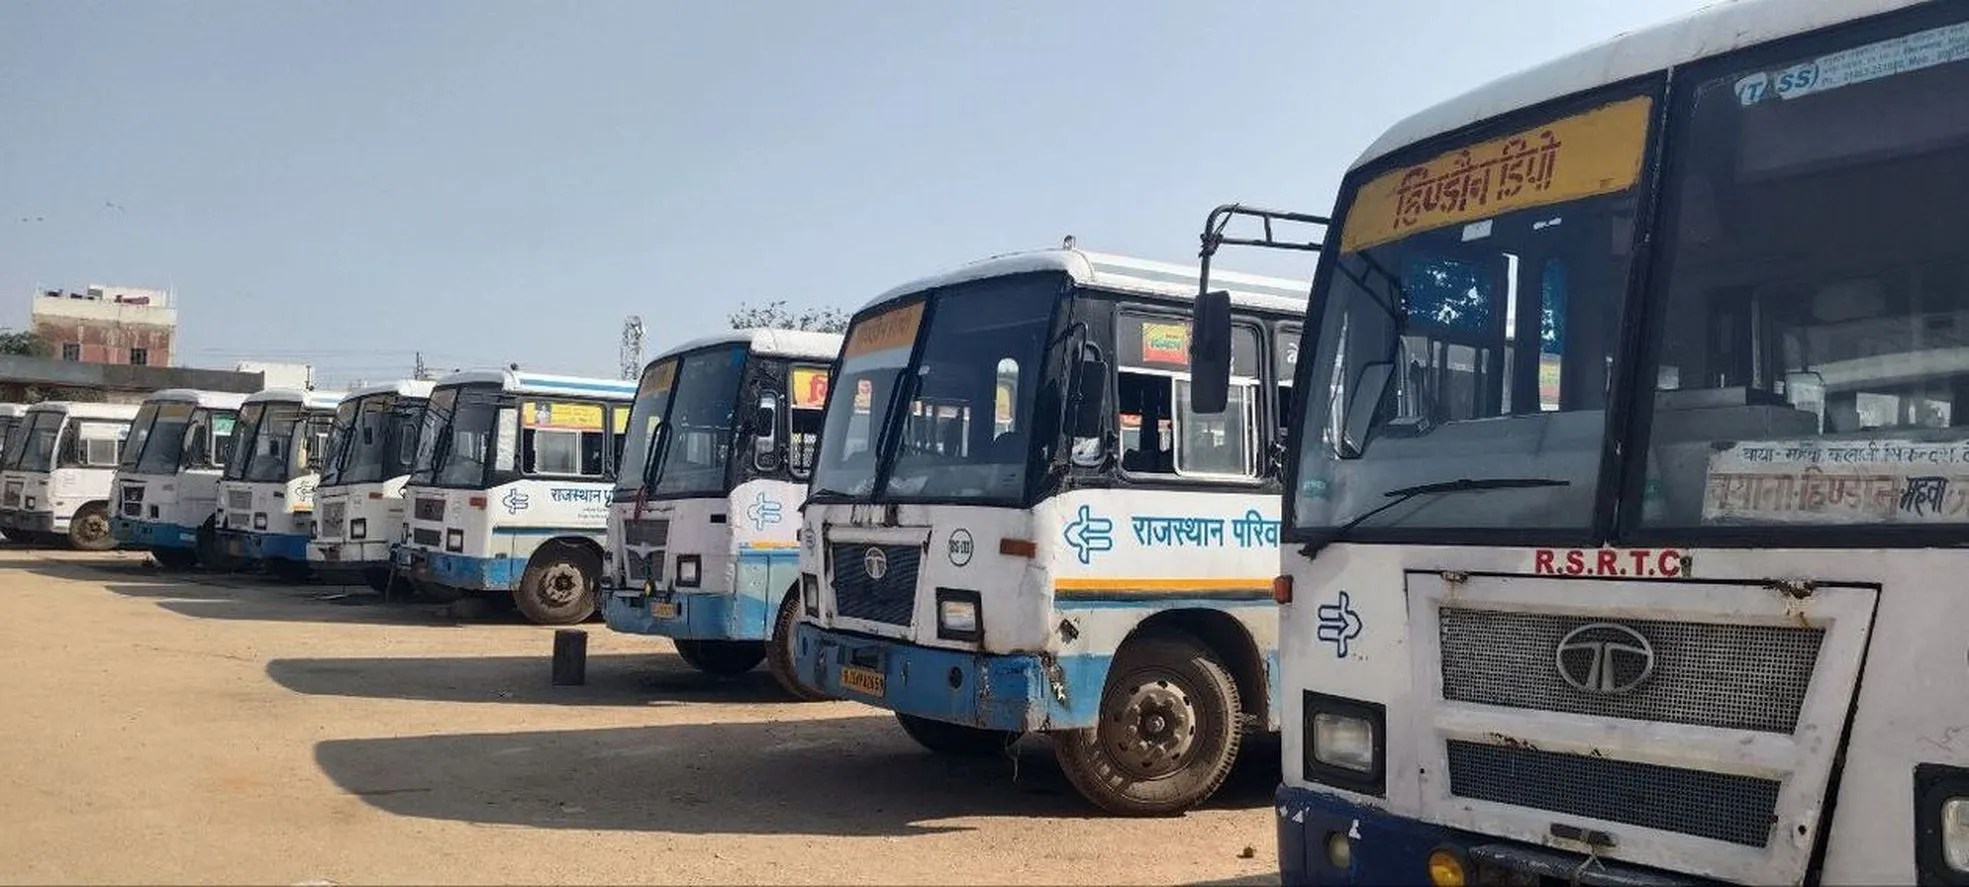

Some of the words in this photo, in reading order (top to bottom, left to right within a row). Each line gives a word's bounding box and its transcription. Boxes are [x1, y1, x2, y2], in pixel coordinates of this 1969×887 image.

[1497, 130, 1562, 200] डिपो
[1131, 516, 1225, 546] राजस्थान
[1231, 509, 1281, 547] परिव
